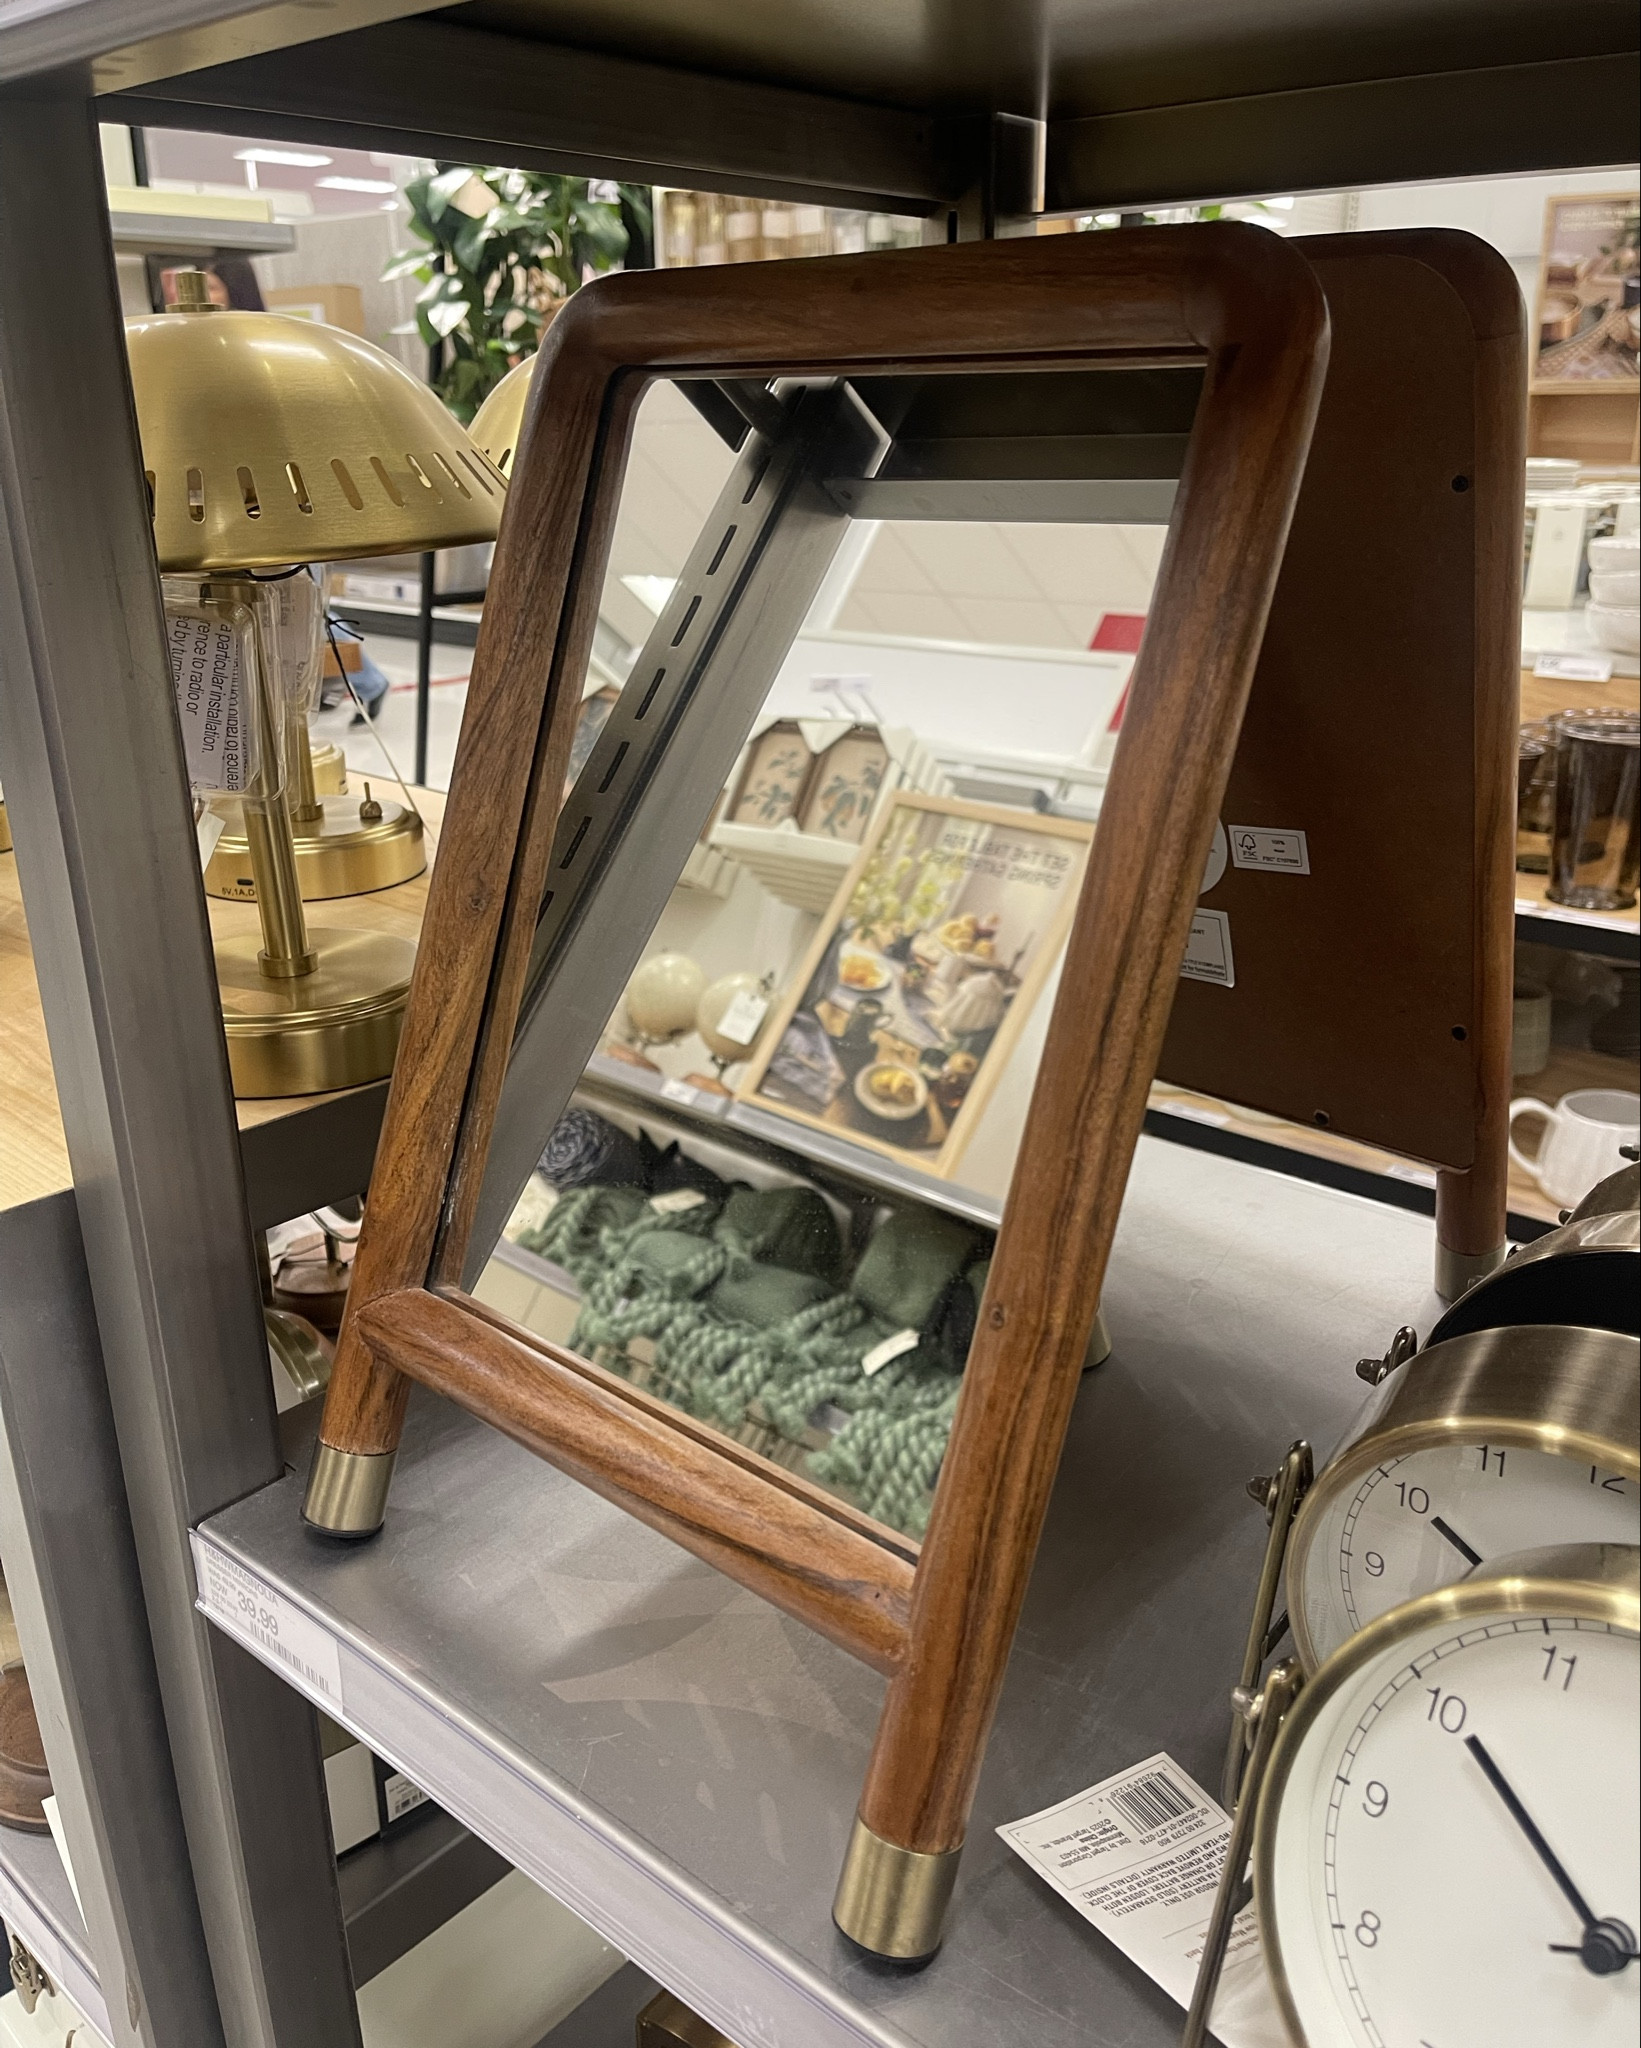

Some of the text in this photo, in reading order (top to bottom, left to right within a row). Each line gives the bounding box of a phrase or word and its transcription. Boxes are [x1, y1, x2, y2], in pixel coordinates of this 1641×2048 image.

[170, 630, 190, 647] by
[192, 657, 208, 669] to
[188, 670, 204, 700] radio
[201, 624, 232, 753] a particular installation.
[185, 702, 198, 716] or
[224, 740, 238, 750] to
[1476, 1444, 1506, 1478] 11
[1394, 1482, 1430, 1514] 10
[1365, 1551, 1384, 1577] 9
[236, 1588, 278, 1638] 39.99
[1542, 1645, 1577, 1692] 11
[1426, 1686, 1467, 1734] 10
[1362, 1780, 1389, 1818] 9
[1173, 1845, 1204, 1862] LIMITED
[1200, 1849, 1218, 1860] AND
[1139, 1857, 1177, 1877] WARRANTY
[1174, 1856, 1203, 1872] REMOVE
[1202, 1861, 1216, 1870] OR
[1107, 1871, 1141, 1889] (DETAILS
[1134, 1874, 1159, 1888] COVER
[1156, 1867, 1177, 1879] BACK
[1177, 1865, 1206, 1881] CHANGE
[1124, 1883, 1137, 1892] OF
[1176, 1874, 1208, 1891] BATTERY
[1109, 1887, 1127, 1898] THE
[1120, 1888, 1150, 1904] LOOSEN
[1154, 1886, 1179, 1900] (SOLD
[1159, 1879, 1220, 1908] INDOOR USE ONLY.
[1100, 1899, 1123, 1912] BOTH
[1354, 1910, 1381, 1948] 8
